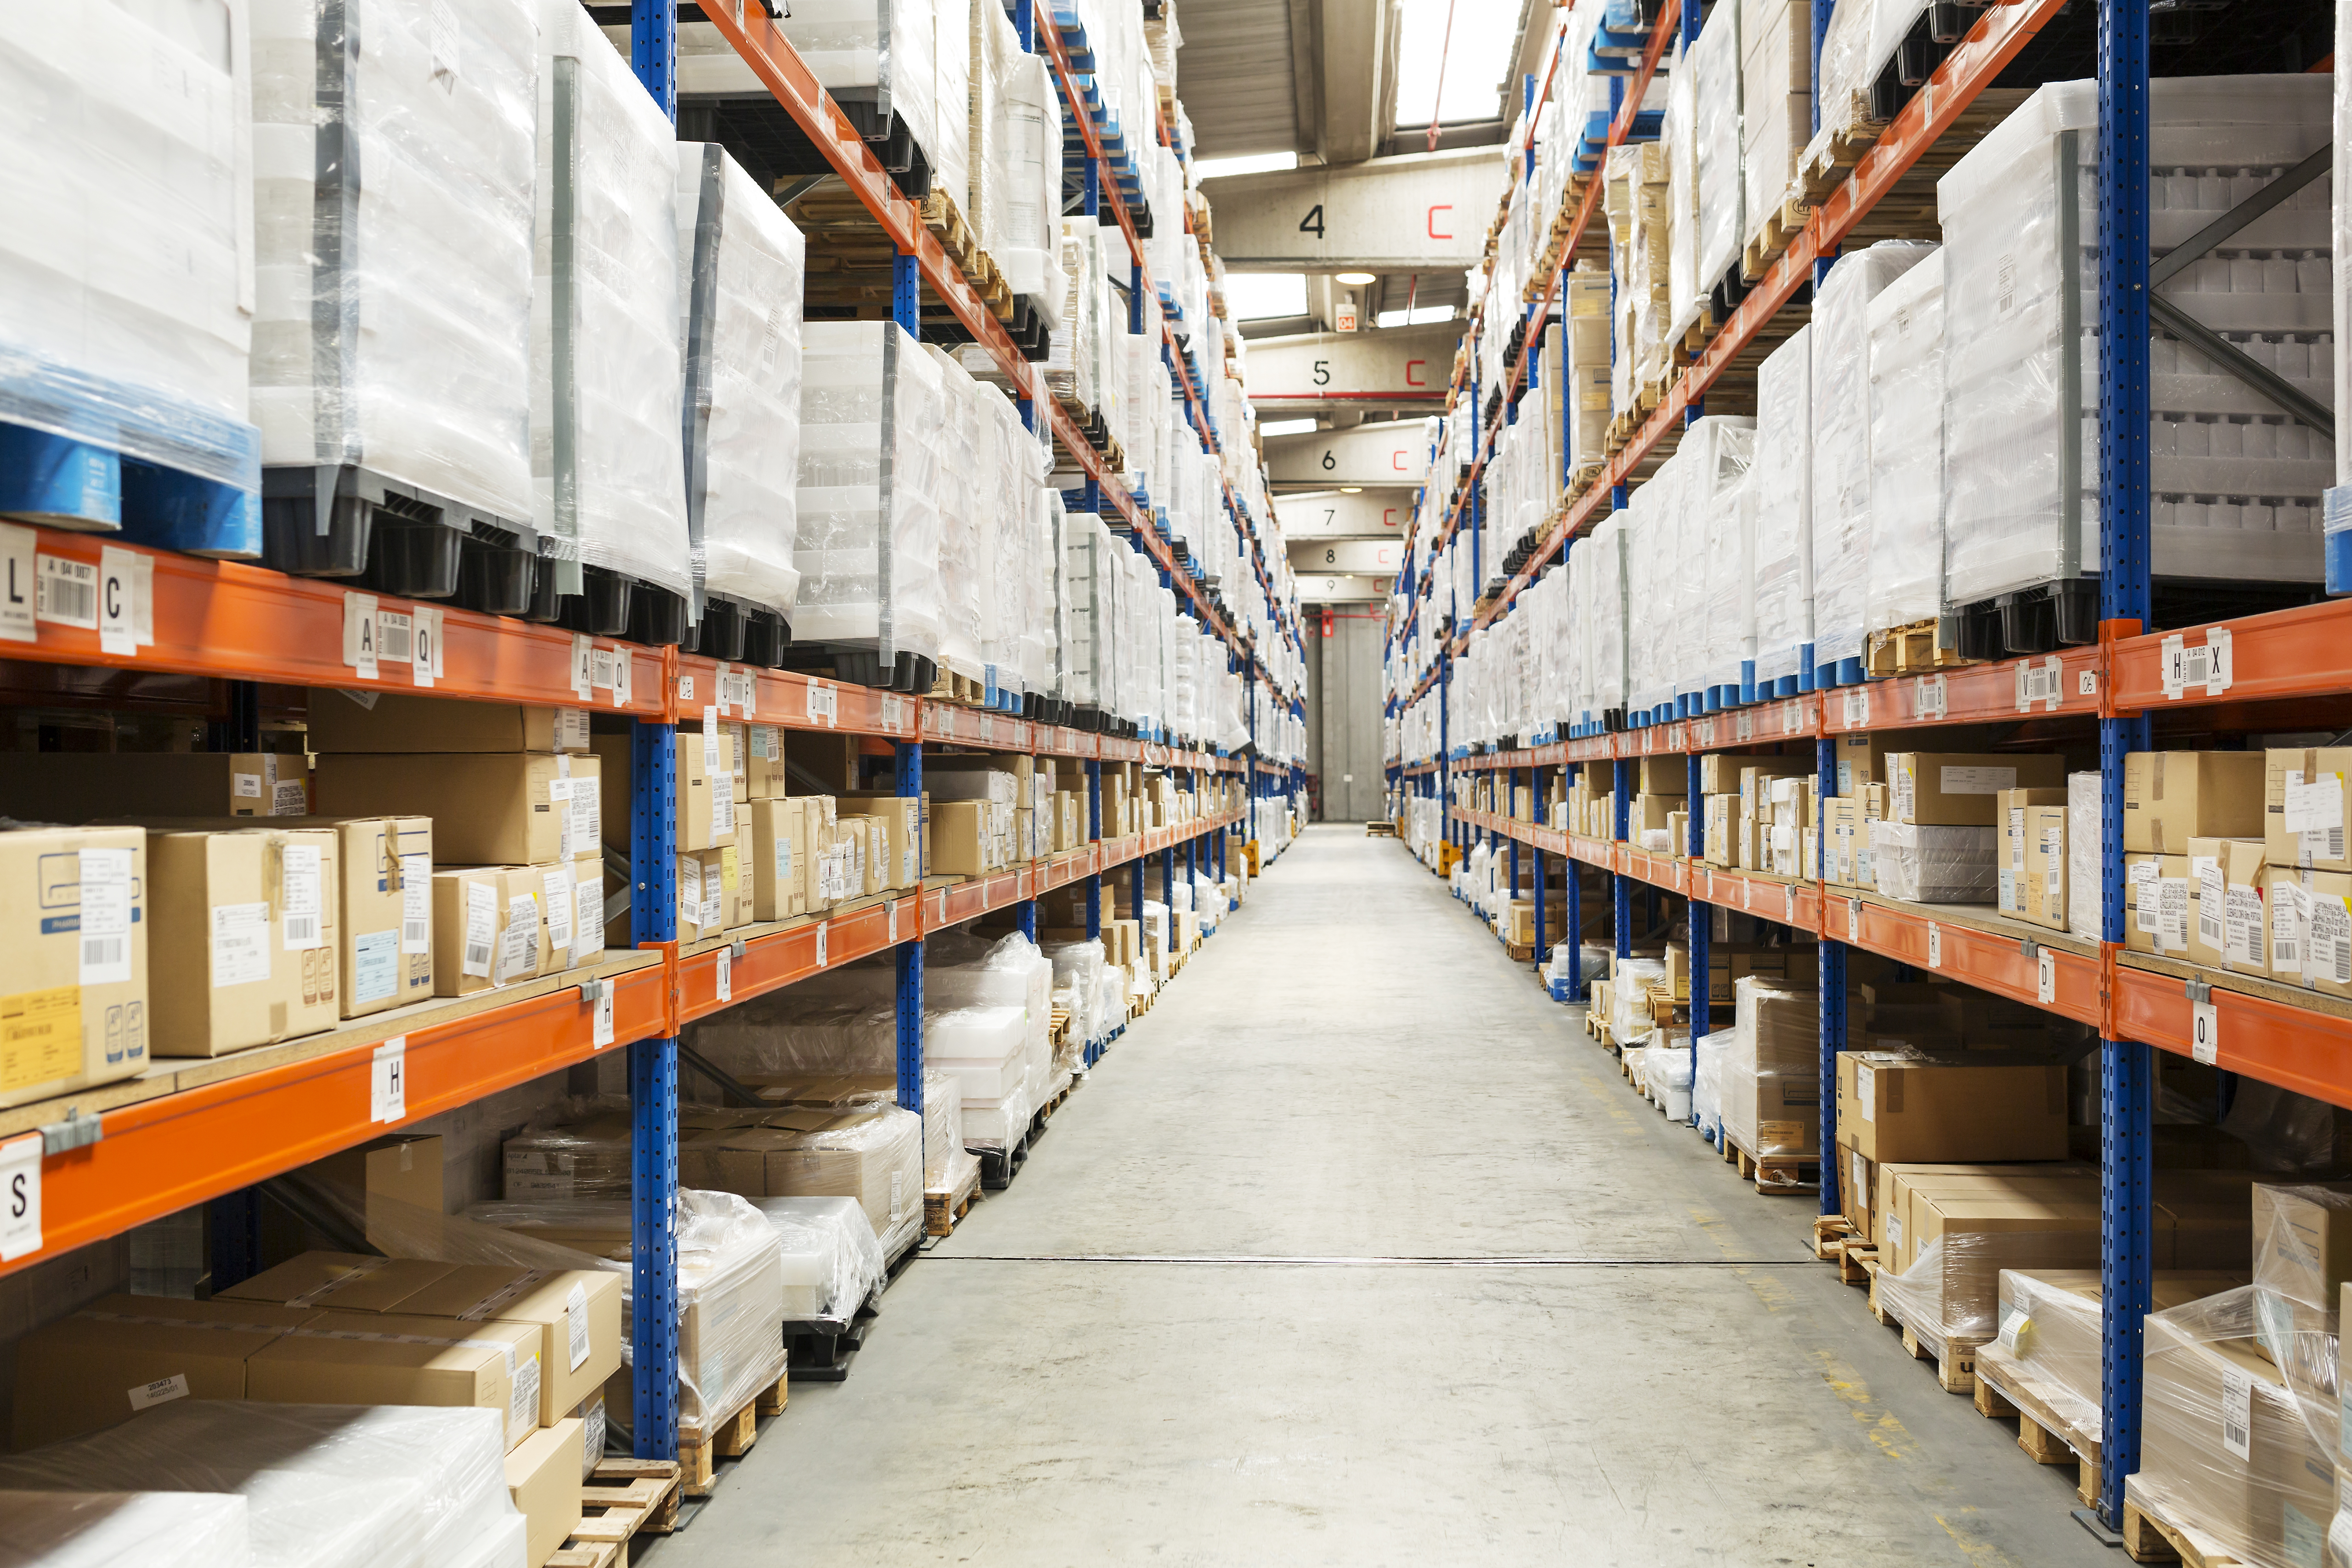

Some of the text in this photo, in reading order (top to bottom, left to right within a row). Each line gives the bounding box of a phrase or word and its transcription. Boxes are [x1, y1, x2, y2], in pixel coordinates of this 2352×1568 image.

[1300, 205, 1452, 239] 4 C
[1340, 317, 1354, 329] 04
[1313, 360, 1425, 385] 5 C
[1323, 451, 1407, 470] 6 C
[1324, 509, 1396, 526] 7 C
[48, 559, 55, 572] A
[1326, 549, 1388, 564] 8 C
[9, 557, 23, 604] L
[1327, 579, 1383, 592] 9 C
[107, 577, 119, 618] C
[362, 618, 372, 651] A
[418, 629, 428, 662] Q
[2193, 648, 2197, 657] 04
[582, 654, 588, 680] A
[2174, 653, 2181, 679] H
[2212, 646, 2220, 674] X
[617, 662, 622, 688] Q
[2050, 671, 2056, 693] M
[2083, 676, 2092, 692] 06
[682, 681, 691, 698] 05
[746, 683, 749, 703] F
[2023, 674, 2028, 696] V
[813, 691, 816, 709] D
[829, 696, 832, 714] T
[1920, 687, 1923, 706] K
[1938, 686, 1941, 705] B
[885, 704, 888, 719] R
[1797, 708, 1800, 723] P
[1848, 701, 1850, 717] Y
[1862, 698, 1865, 714] P
[893, 912, 896, 928] Y
[1850, 911, 1853, 927] G
[822, 934, 825, 952] K
[1931, 934, 1935, 953] R
[724, 963, 729, 984] V
[2042, 963, 2047, 985] D
[605, 998, 610, 1024] H
[391, 1061, 399, 1094] H
[12, 1173, 26, 1218] S
[147, 1378, 172, 1391] 203473
